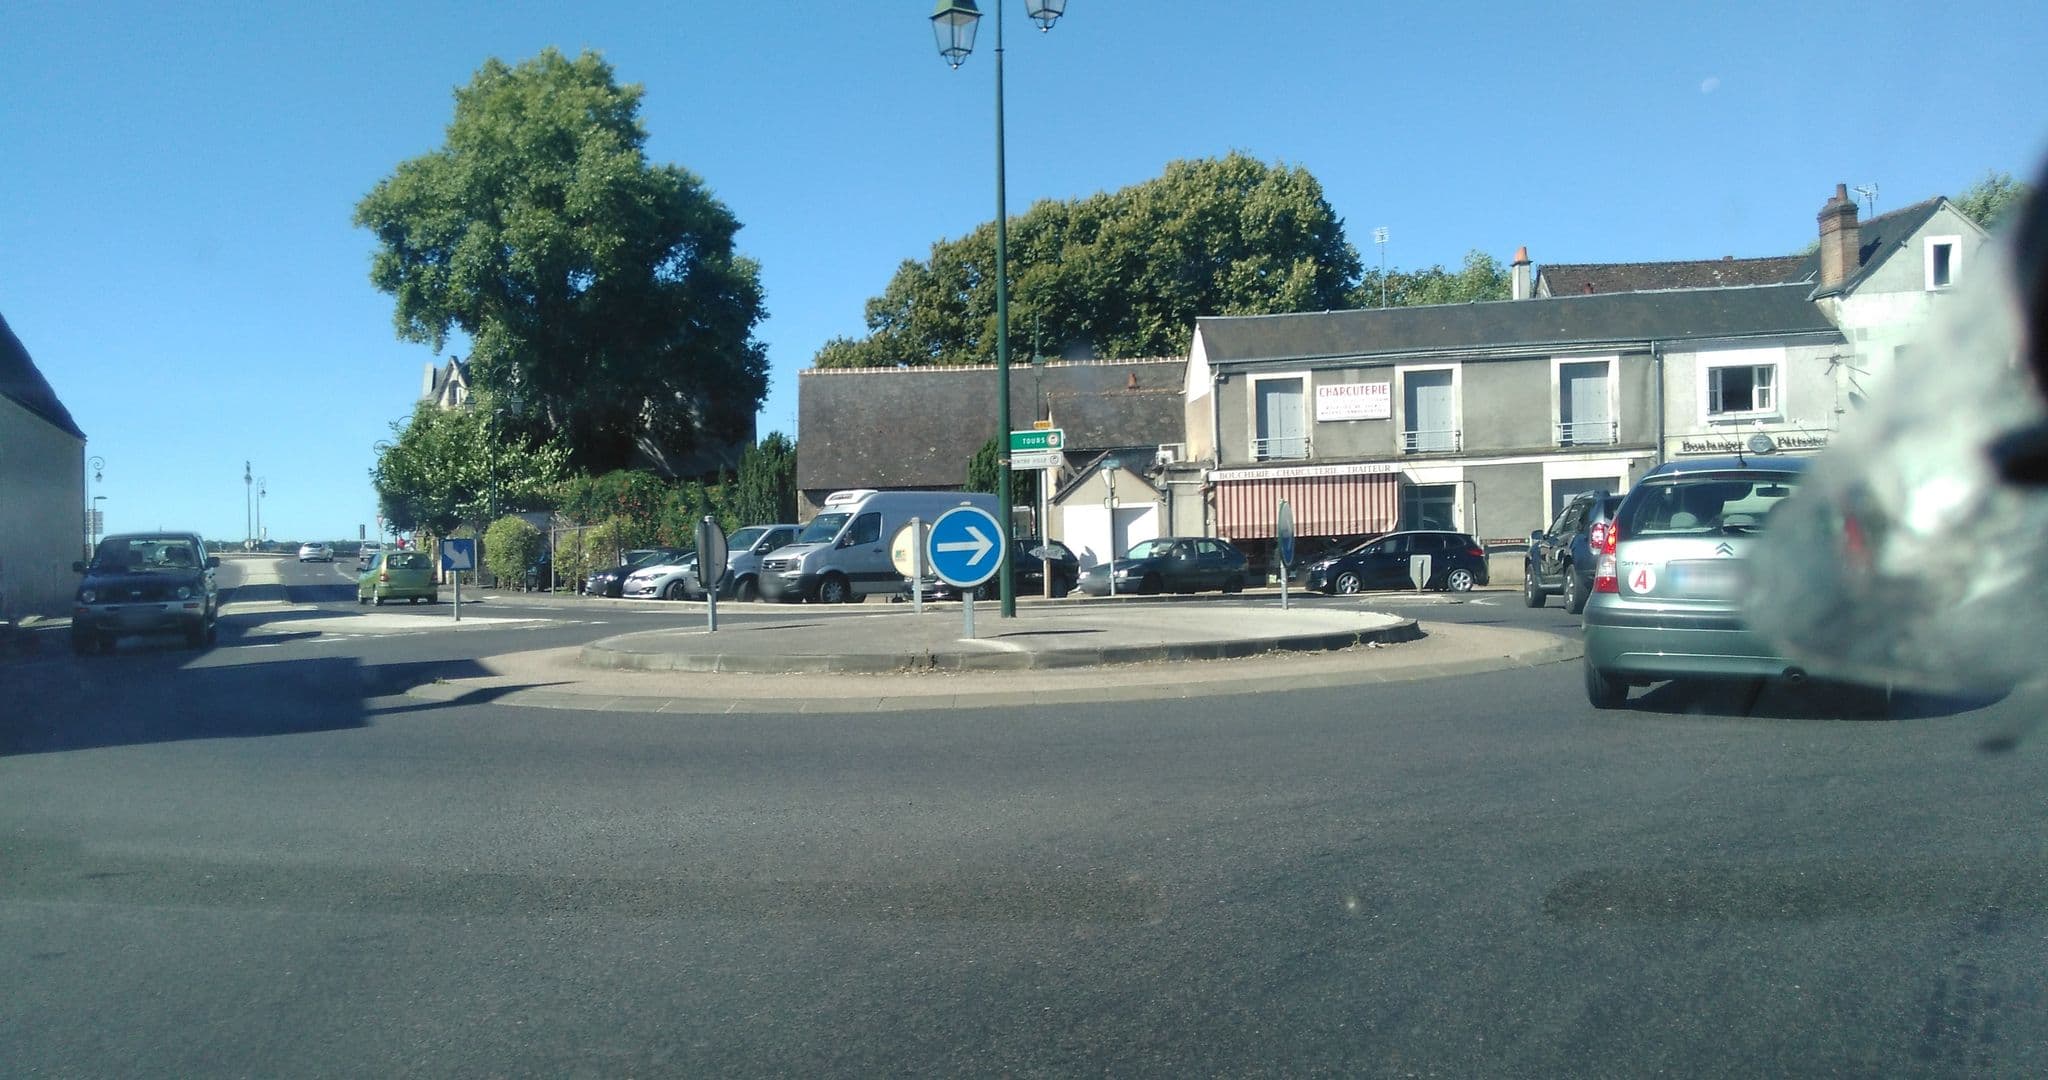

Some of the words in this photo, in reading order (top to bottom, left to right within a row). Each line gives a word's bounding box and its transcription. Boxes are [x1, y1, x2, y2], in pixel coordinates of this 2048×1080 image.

[1319, 385, 1388, 397] CHARCUTERIE
[1022, 437, 1046, 445] TOURS
[1219, 470, 1270, 480] BOUCHERIE
[1276, 466, 1337, 477] CHARCUTERIE
[1347, 464, 1391, 474] TRAITEUR
[1634, 569, 1647, 589] A
